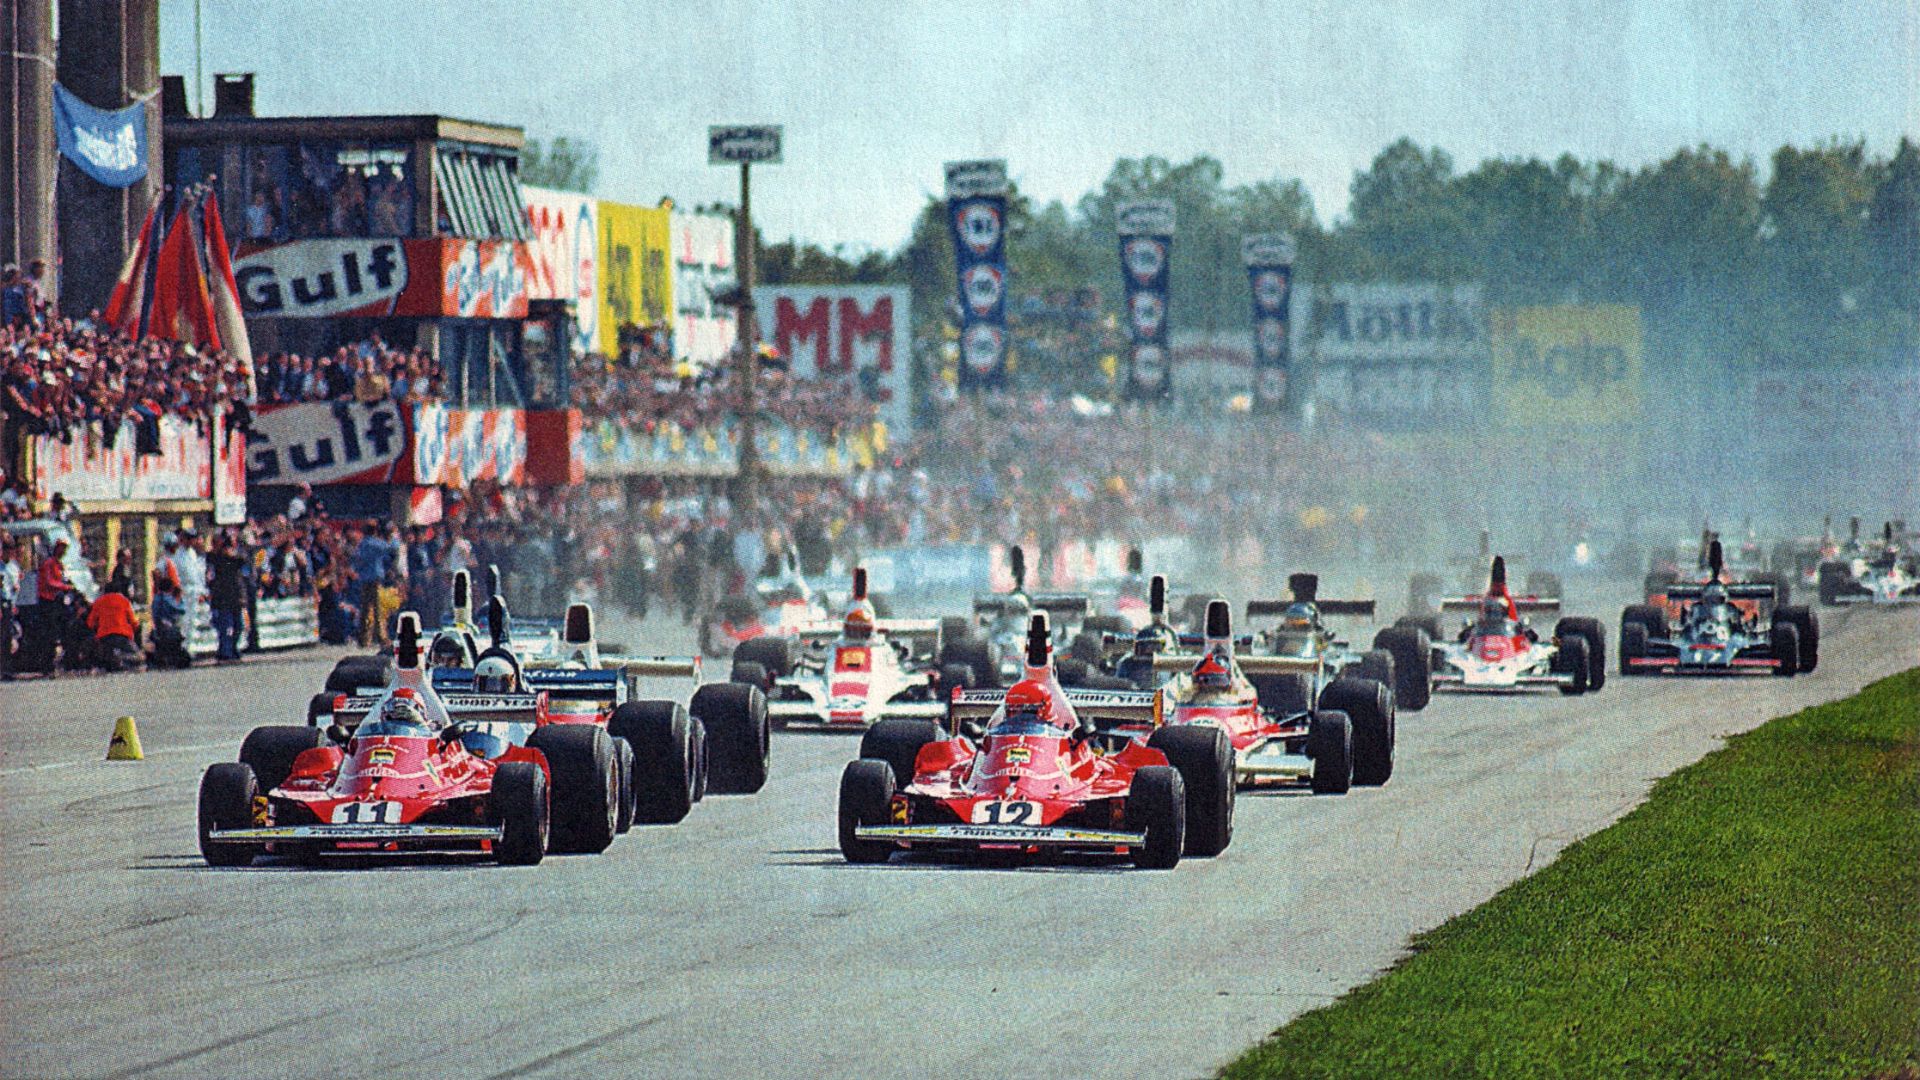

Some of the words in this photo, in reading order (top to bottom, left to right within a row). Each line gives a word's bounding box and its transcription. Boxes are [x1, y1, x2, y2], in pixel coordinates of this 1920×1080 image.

[235, 245, 396, 311] Gulf
[342, 802, 388, 824] 11
[985, 802, 1032, 825] 12
